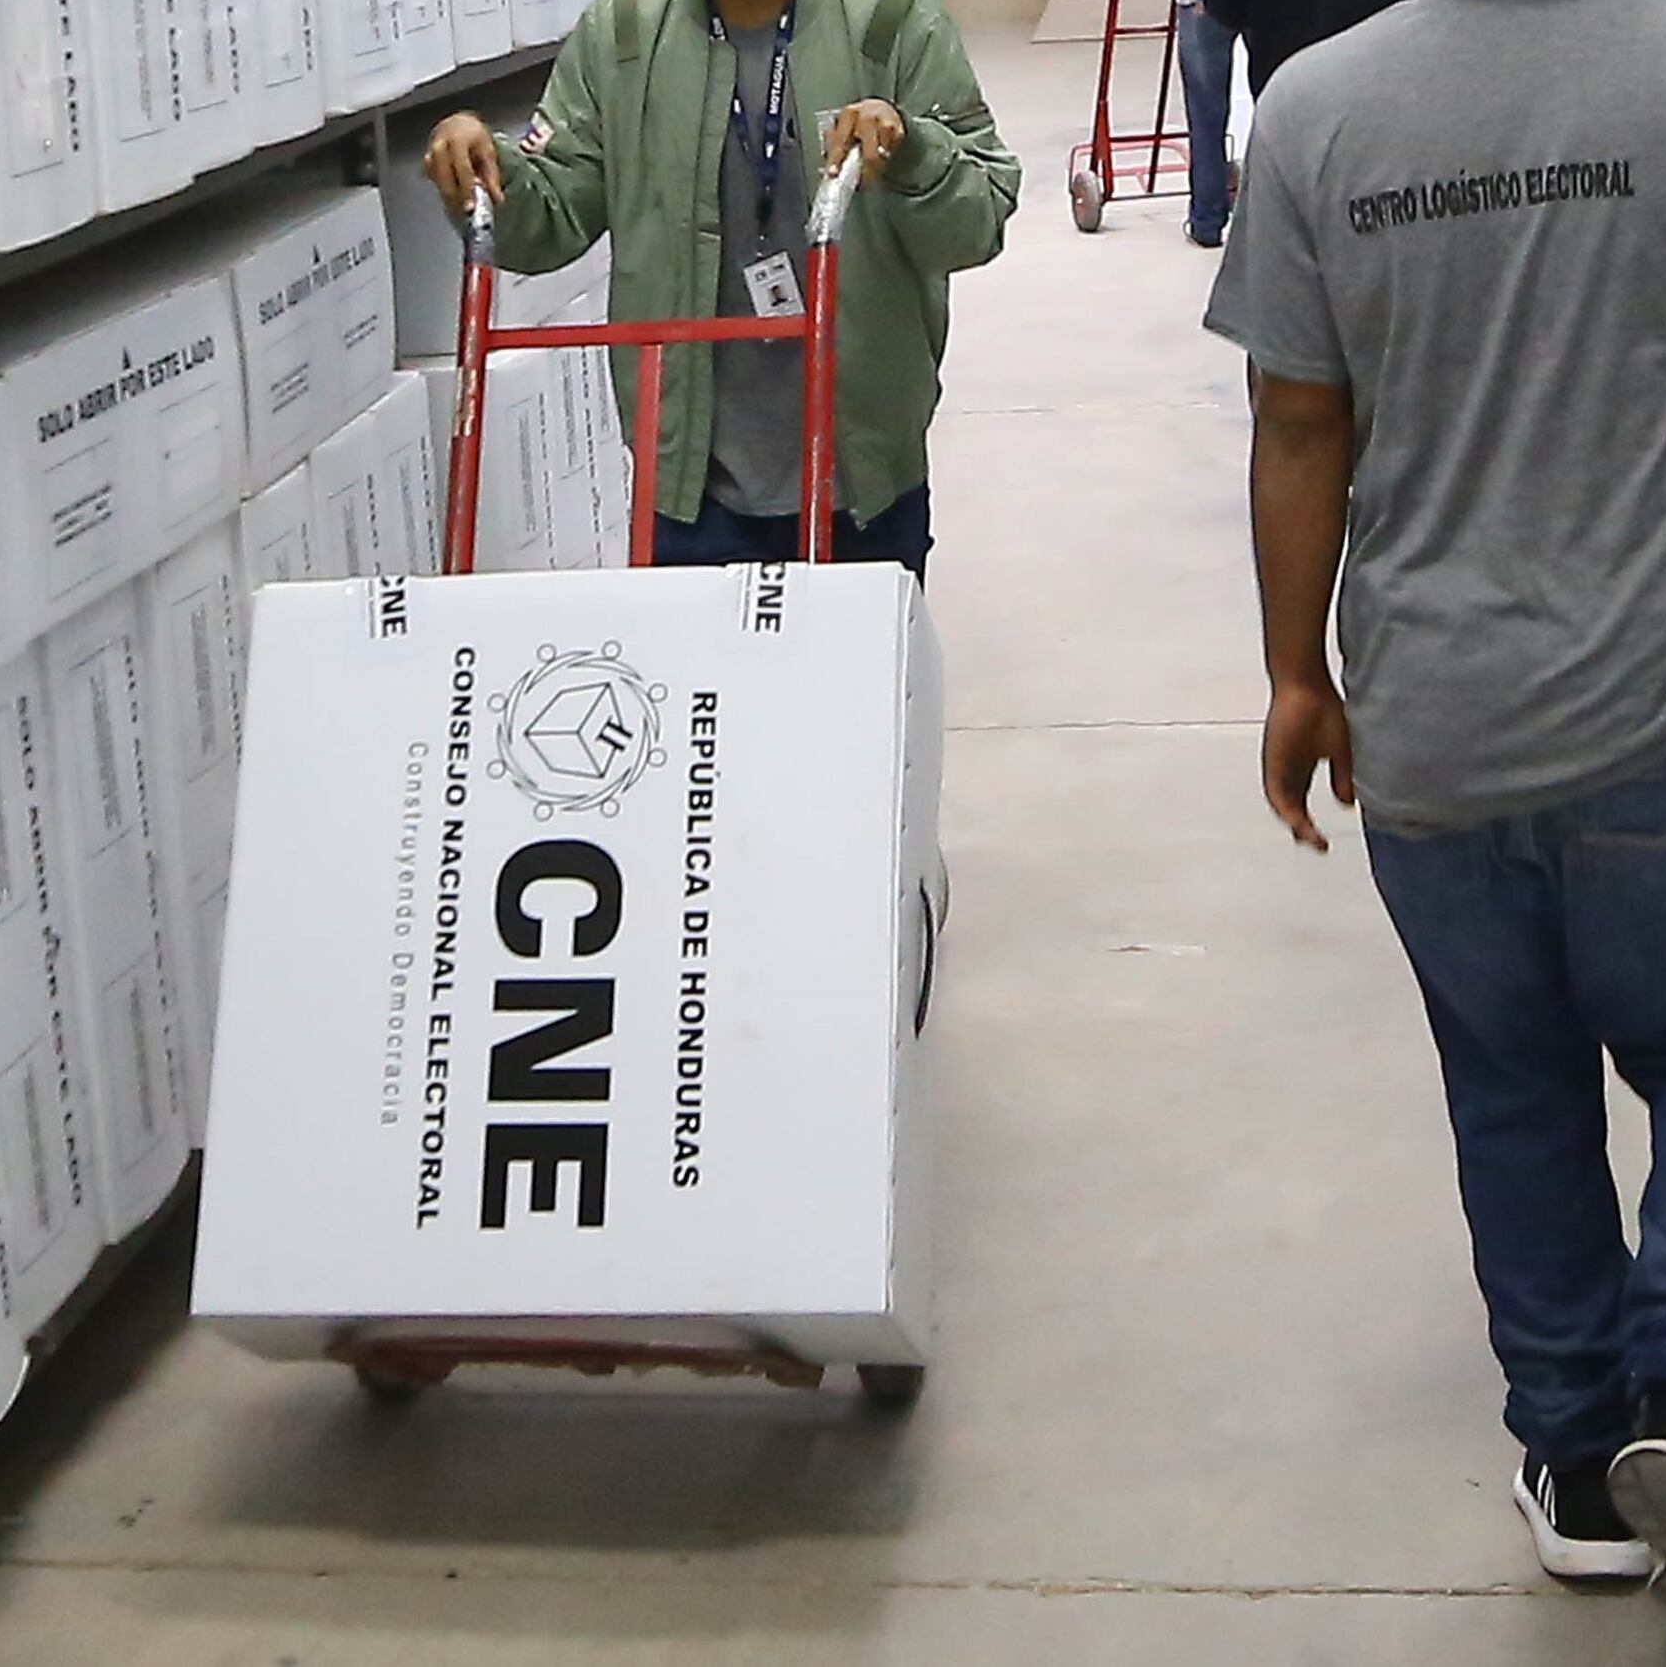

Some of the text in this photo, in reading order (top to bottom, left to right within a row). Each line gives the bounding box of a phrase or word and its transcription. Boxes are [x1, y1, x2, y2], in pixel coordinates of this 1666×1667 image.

[1348, 160, 1635, 234] CENTRO LOGÍSTICO ELECTORAL
[754, 562, 786, 633] CNE
[380, 742, 428, 1125] Construyendo Democracia
[416, 647, 475, 1228] CONSEJO NACIONAL ELECTORAL
[479, 837, 624, 1231] CNE
[673, 691, 721, 1189] REPÚBLICA DE HONDURAS
